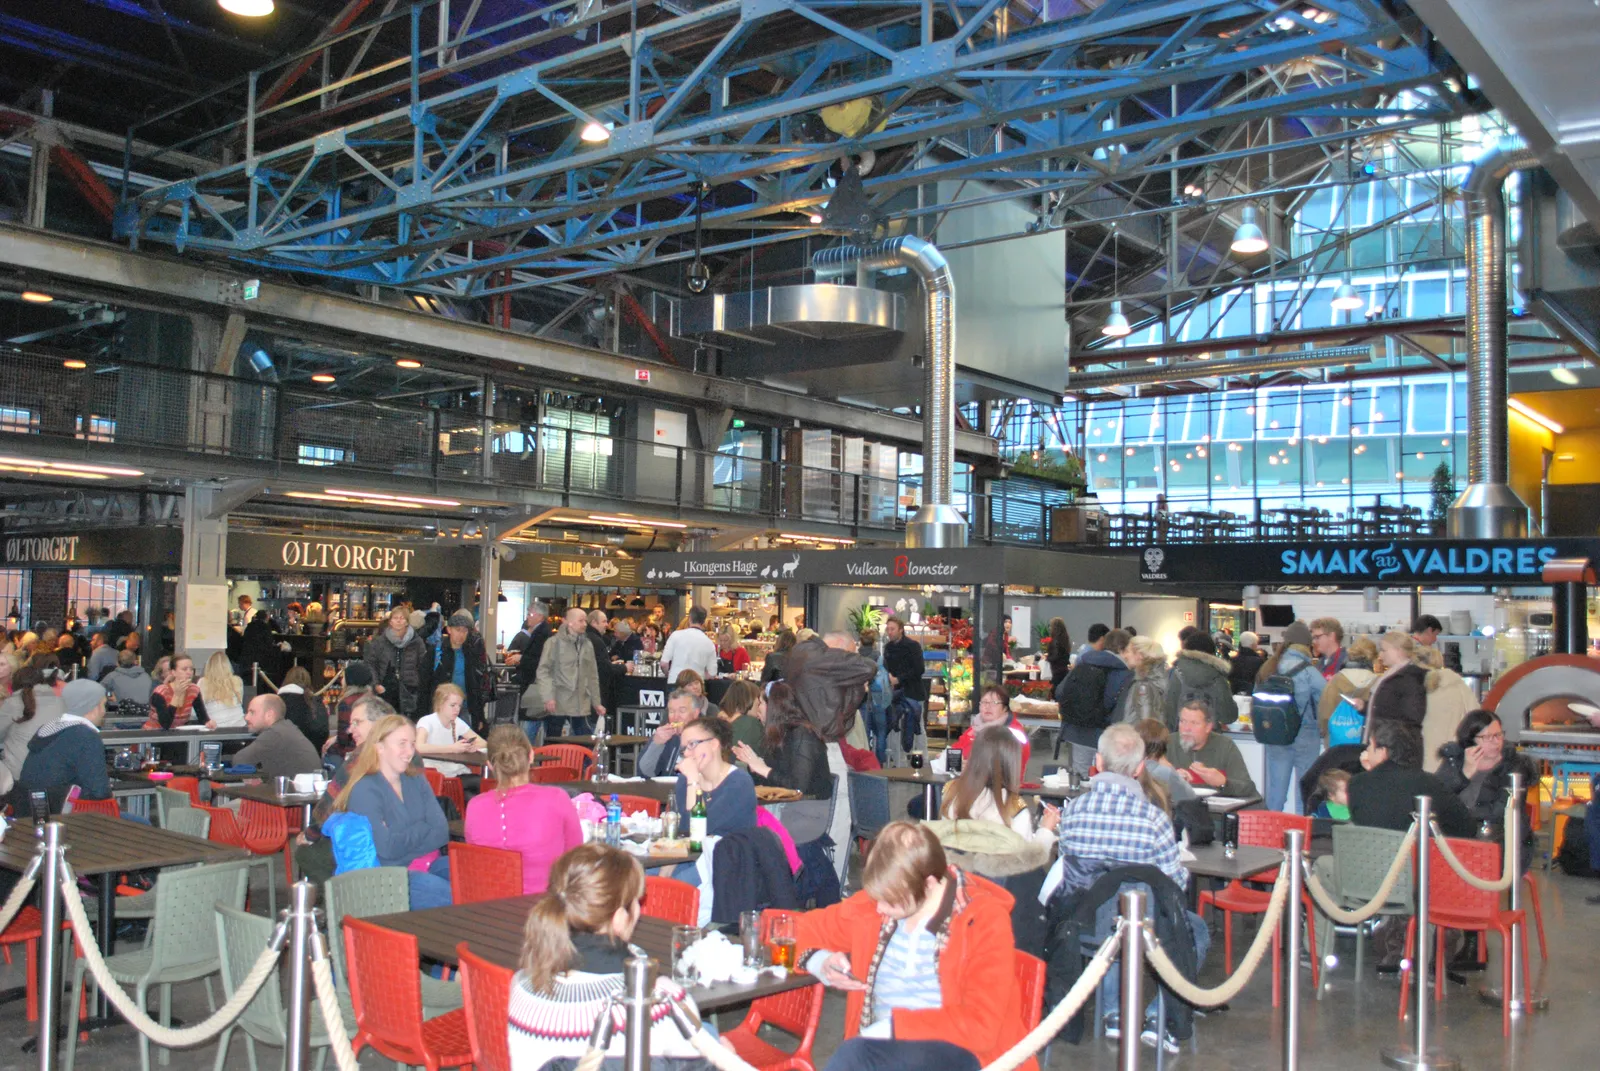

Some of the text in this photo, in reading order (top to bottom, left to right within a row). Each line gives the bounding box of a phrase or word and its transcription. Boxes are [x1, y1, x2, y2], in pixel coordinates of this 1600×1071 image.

[6, 536, 79, 562] ØLTORGET
[282, 540, 415, 572] ØLTORGET
[1281, 549, 1370, 575] SMAK
[1402, 547, 1556, 575] VALDRES
[684, 561, 757, 576] I Kongens Hage
[846, 555, 958, 577] Vulkan Blomster
